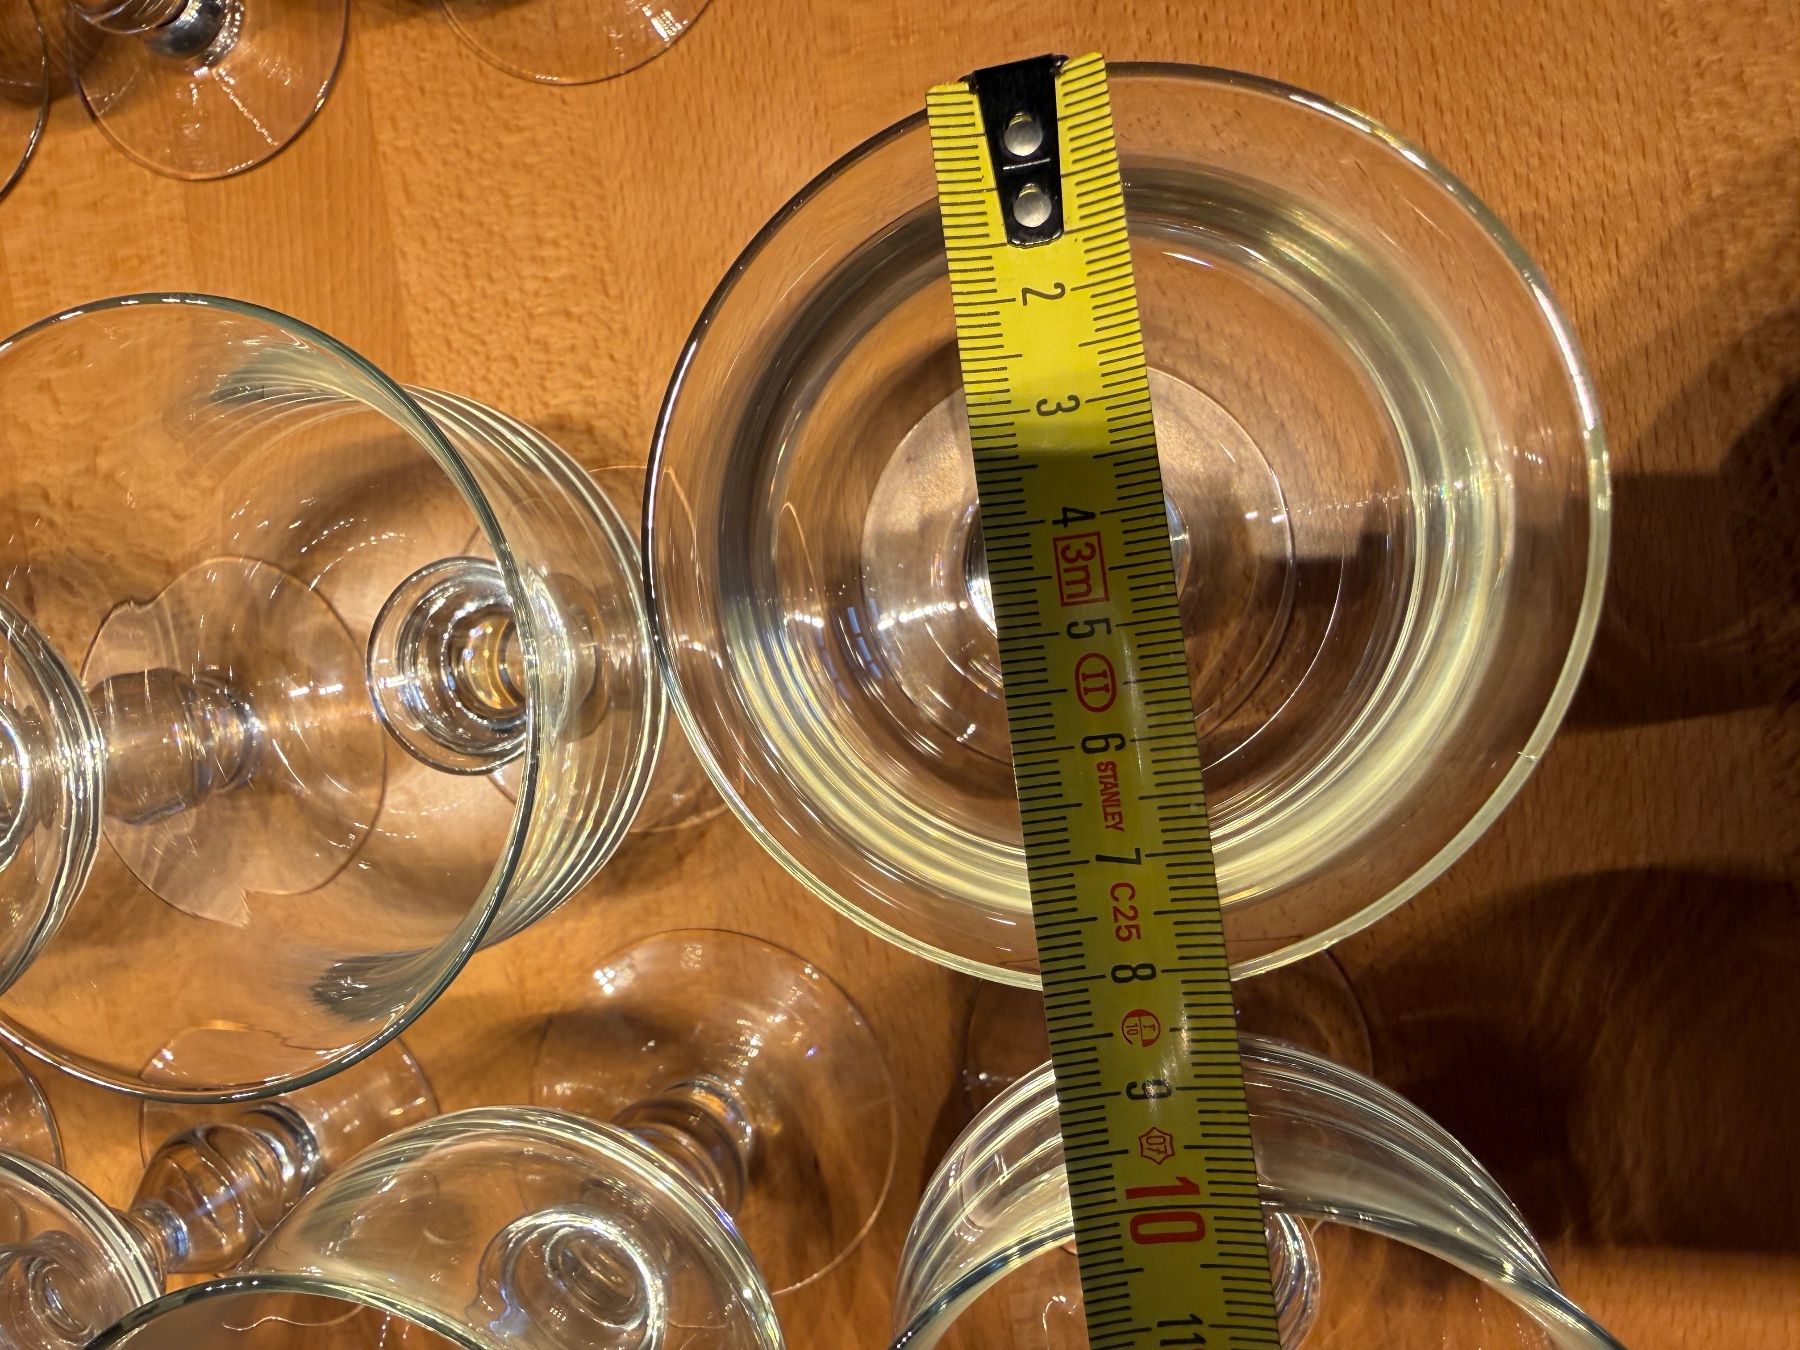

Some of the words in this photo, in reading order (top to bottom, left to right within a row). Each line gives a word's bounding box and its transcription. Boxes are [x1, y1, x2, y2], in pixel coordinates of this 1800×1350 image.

[1021, 281, 1066, 307] 2
[1035, 394, 1081, 417] 3
[1052, 506, 1097, 528] 4
[1060, 541, 1097, 600] 3m
[1066, 617, 1112, 639] 5
[1080, 733, 1126, 754] 6
[1096, 760, 1125, 832] STANLEY
[1095, 847, 1142, 866] 7
[1110, 963, 1157, 983] 8
[1125, 1079, 1172, 1101] 9
[1125, 1176, 1206, 1245] 10
[1156, 1312, 1207, 1347] 11
